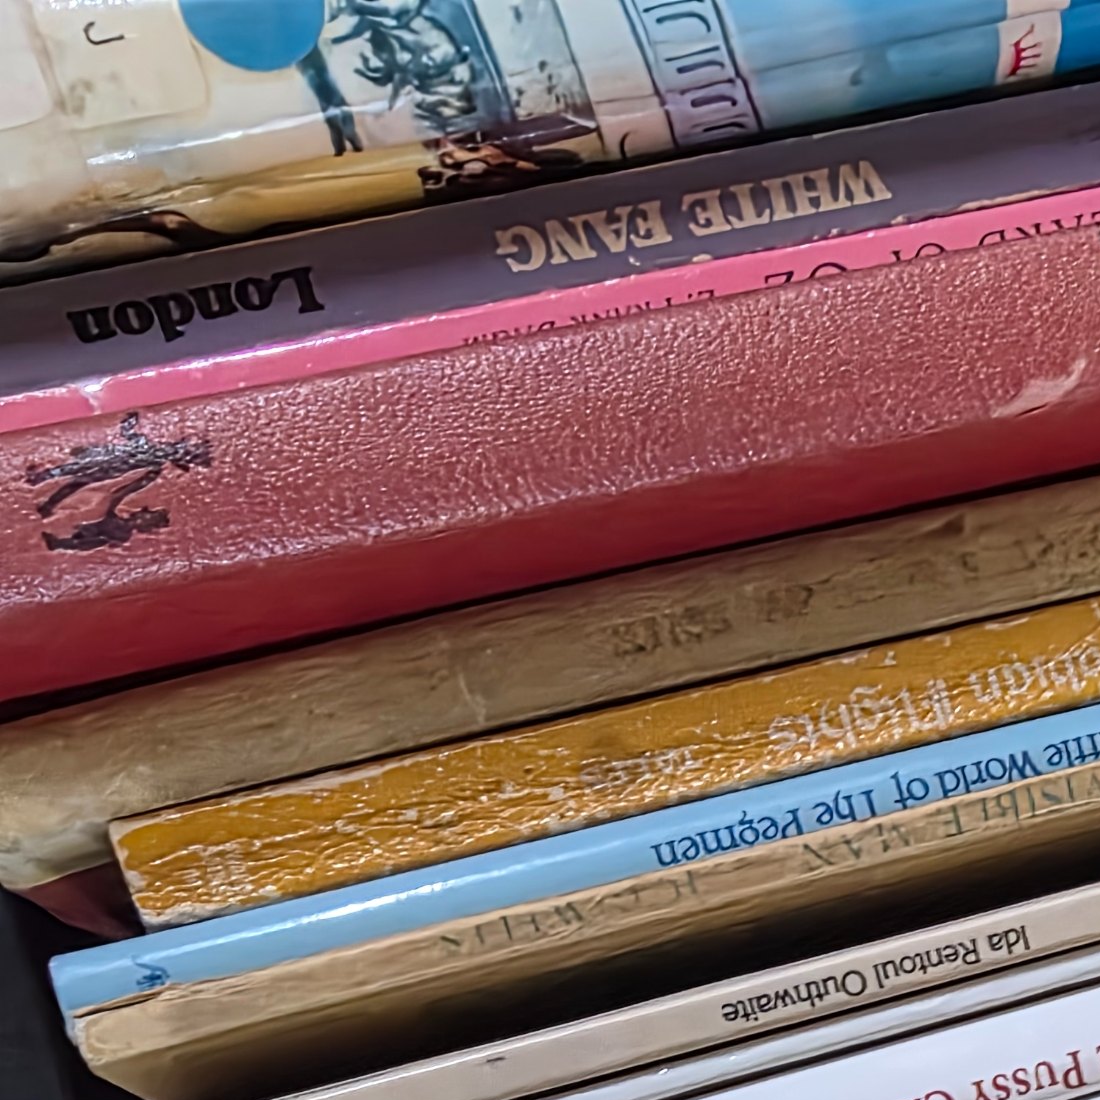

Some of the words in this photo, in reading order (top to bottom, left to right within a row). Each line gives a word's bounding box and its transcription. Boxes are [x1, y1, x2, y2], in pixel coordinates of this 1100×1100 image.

[681, 158, 893, 237] WHITE
[495, 212, 674, 274] FANG
[67, 266, 326, 346] London
[933, 750, 1043, 795] World
[814, 789, 878, 822] The
[650, 808, 804, 868] Pegmen
[874, 940, 982, 990] Rentoul
[988, 926, 1030, 957] Ida
[720, 968, 869, 1024] Outhwaite
